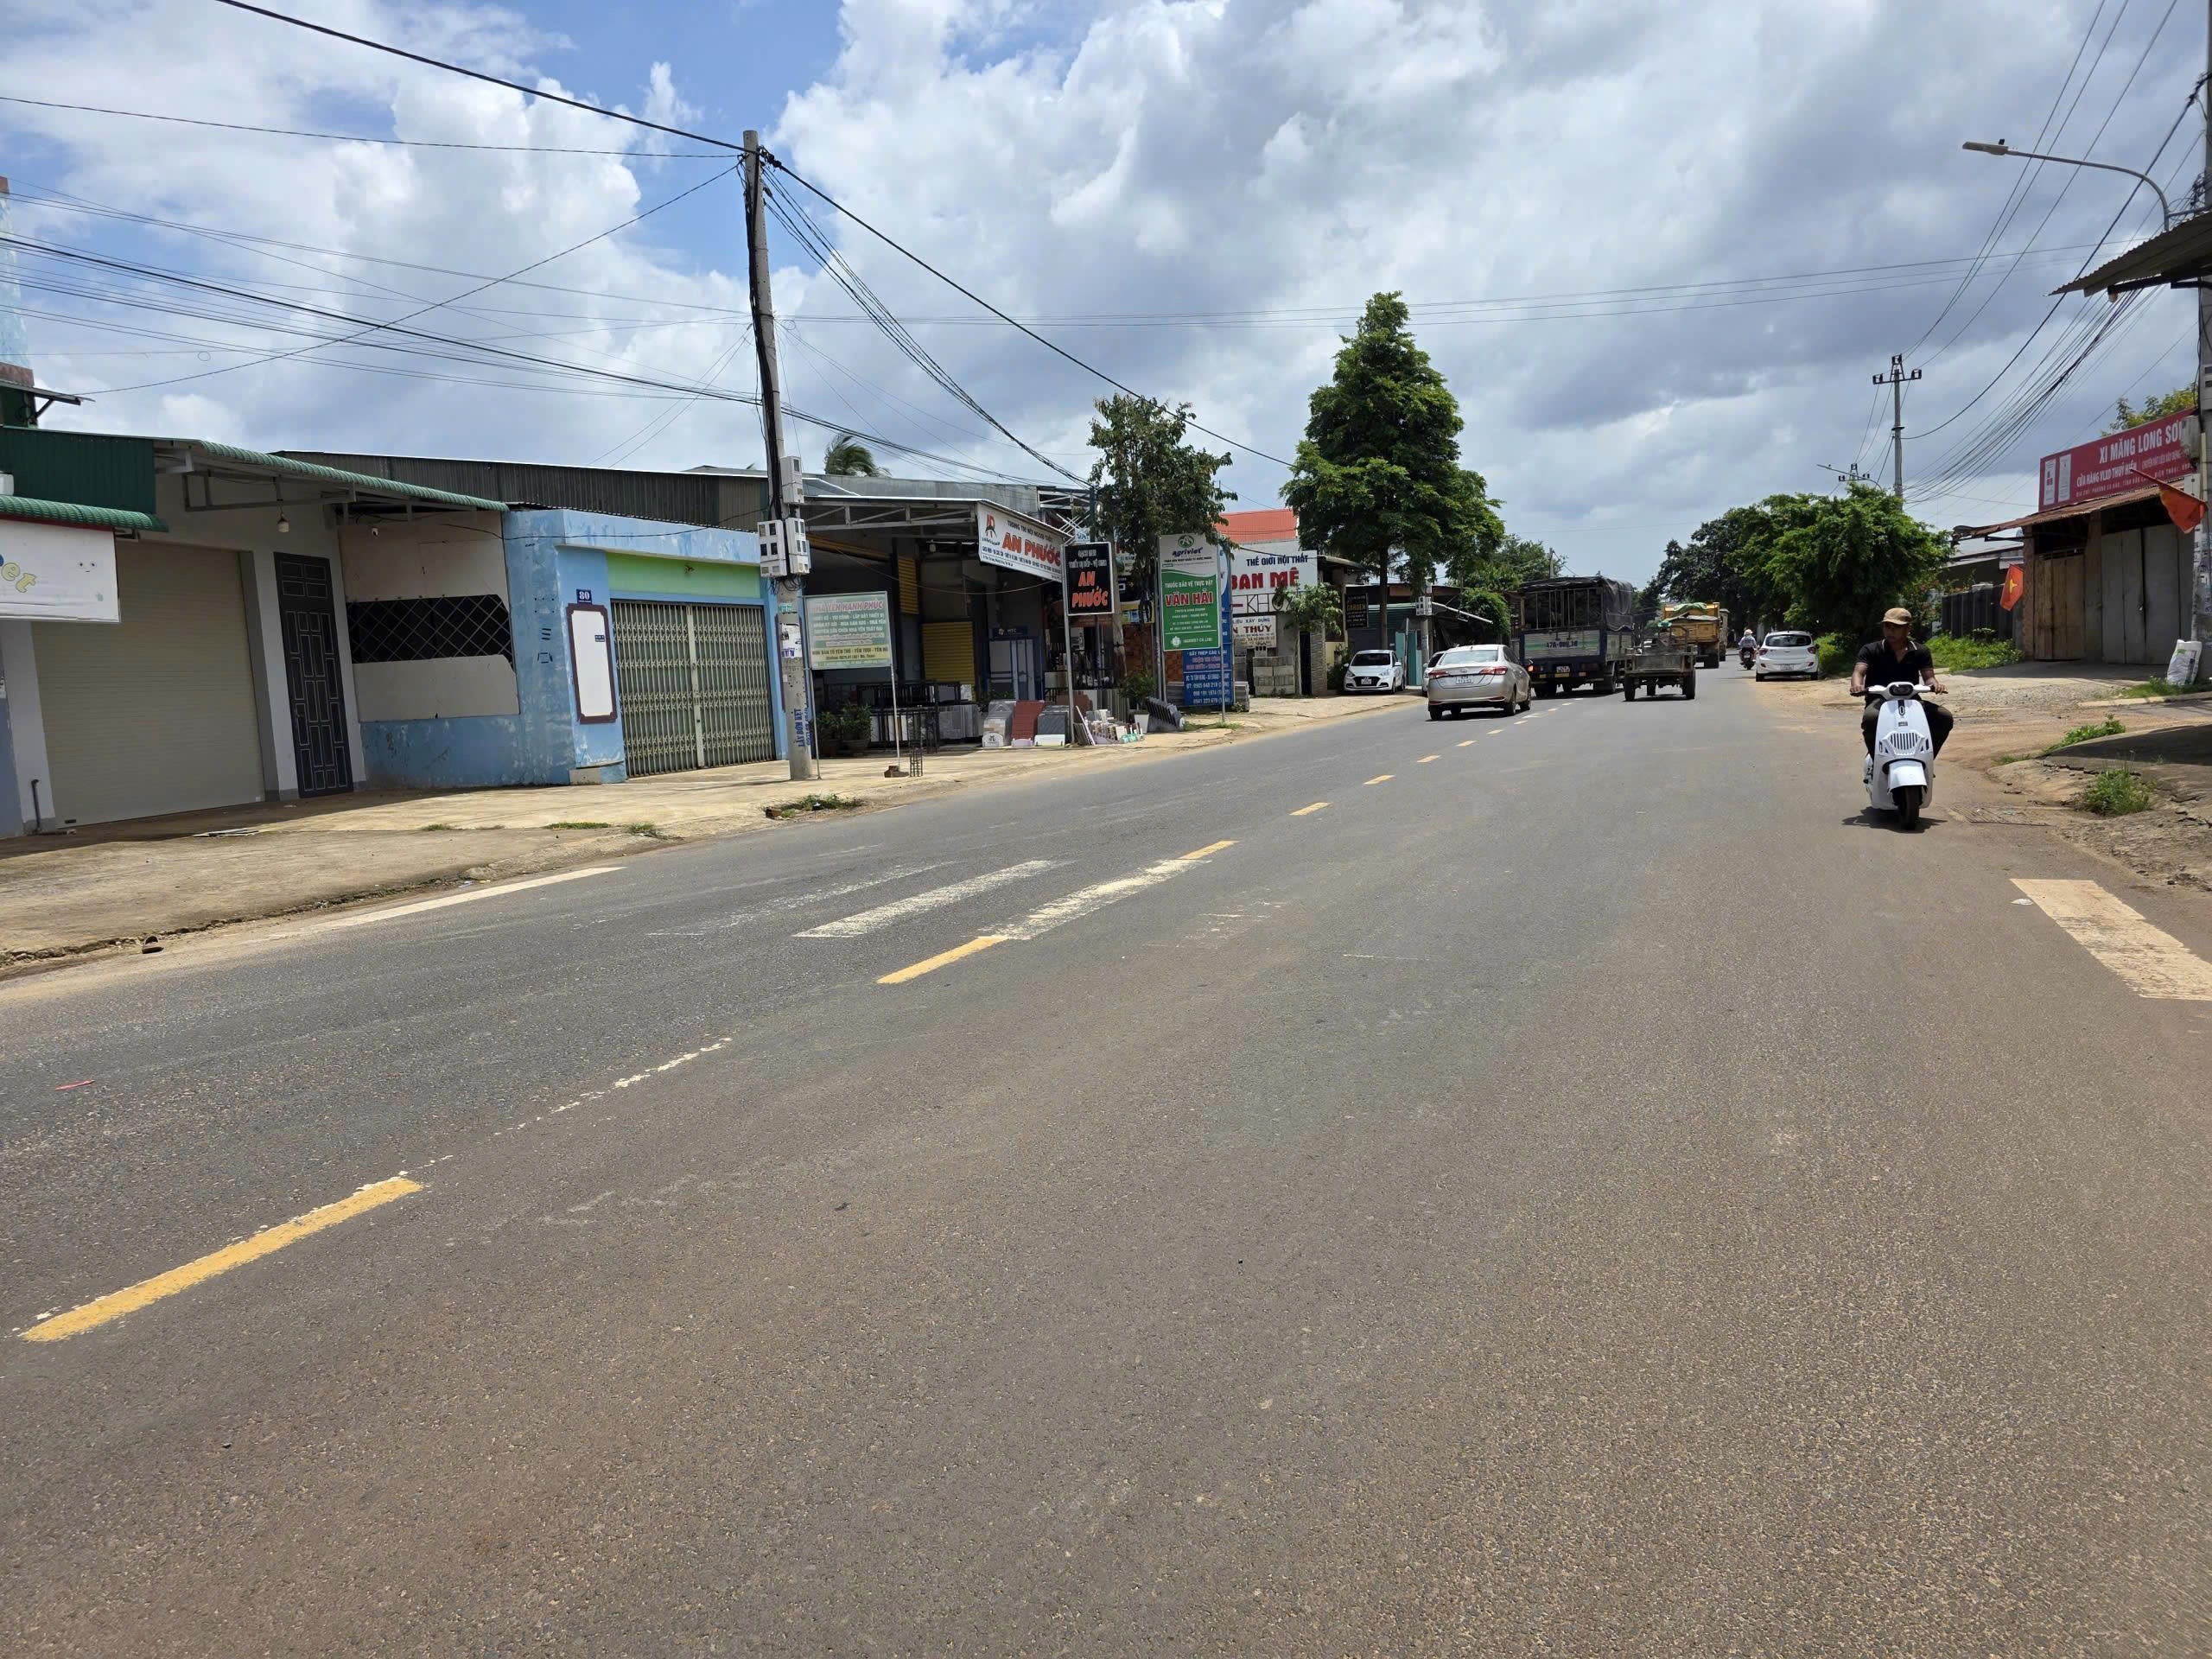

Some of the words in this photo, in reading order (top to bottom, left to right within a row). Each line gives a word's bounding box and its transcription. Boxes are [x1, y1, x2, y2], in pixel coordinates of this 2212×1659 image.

[2099, 446, 2107, 464] XI
[2110, 438, 2136, 461] MĂNG
[2138, 429, 2162, 454] LONG
[1002, 531, 1022, 554] AN
[1024, 538, 1061, 567] PHƯỚC
[1246, 556, 1260, 567] THẾ
[1262, 557, 1275, 566] GIỚI
[1277, 555, 1290, 566] NỘI
[1291, 553, 1308, 563] THẤT
[1078, 570, 1096, 587] AN
[1231, 573, 1264, 590] BAN
[1270, 567, 1300, 588] MÊ
[579, 591, 590, 601] 80
[864, 598, 883, 610] PHÚC
[1071, 585, 1109, 608] PHƯỚC
[1192, 588, 1214, 605] HẢI
[1243, 623, 1272, 633] THÚY
